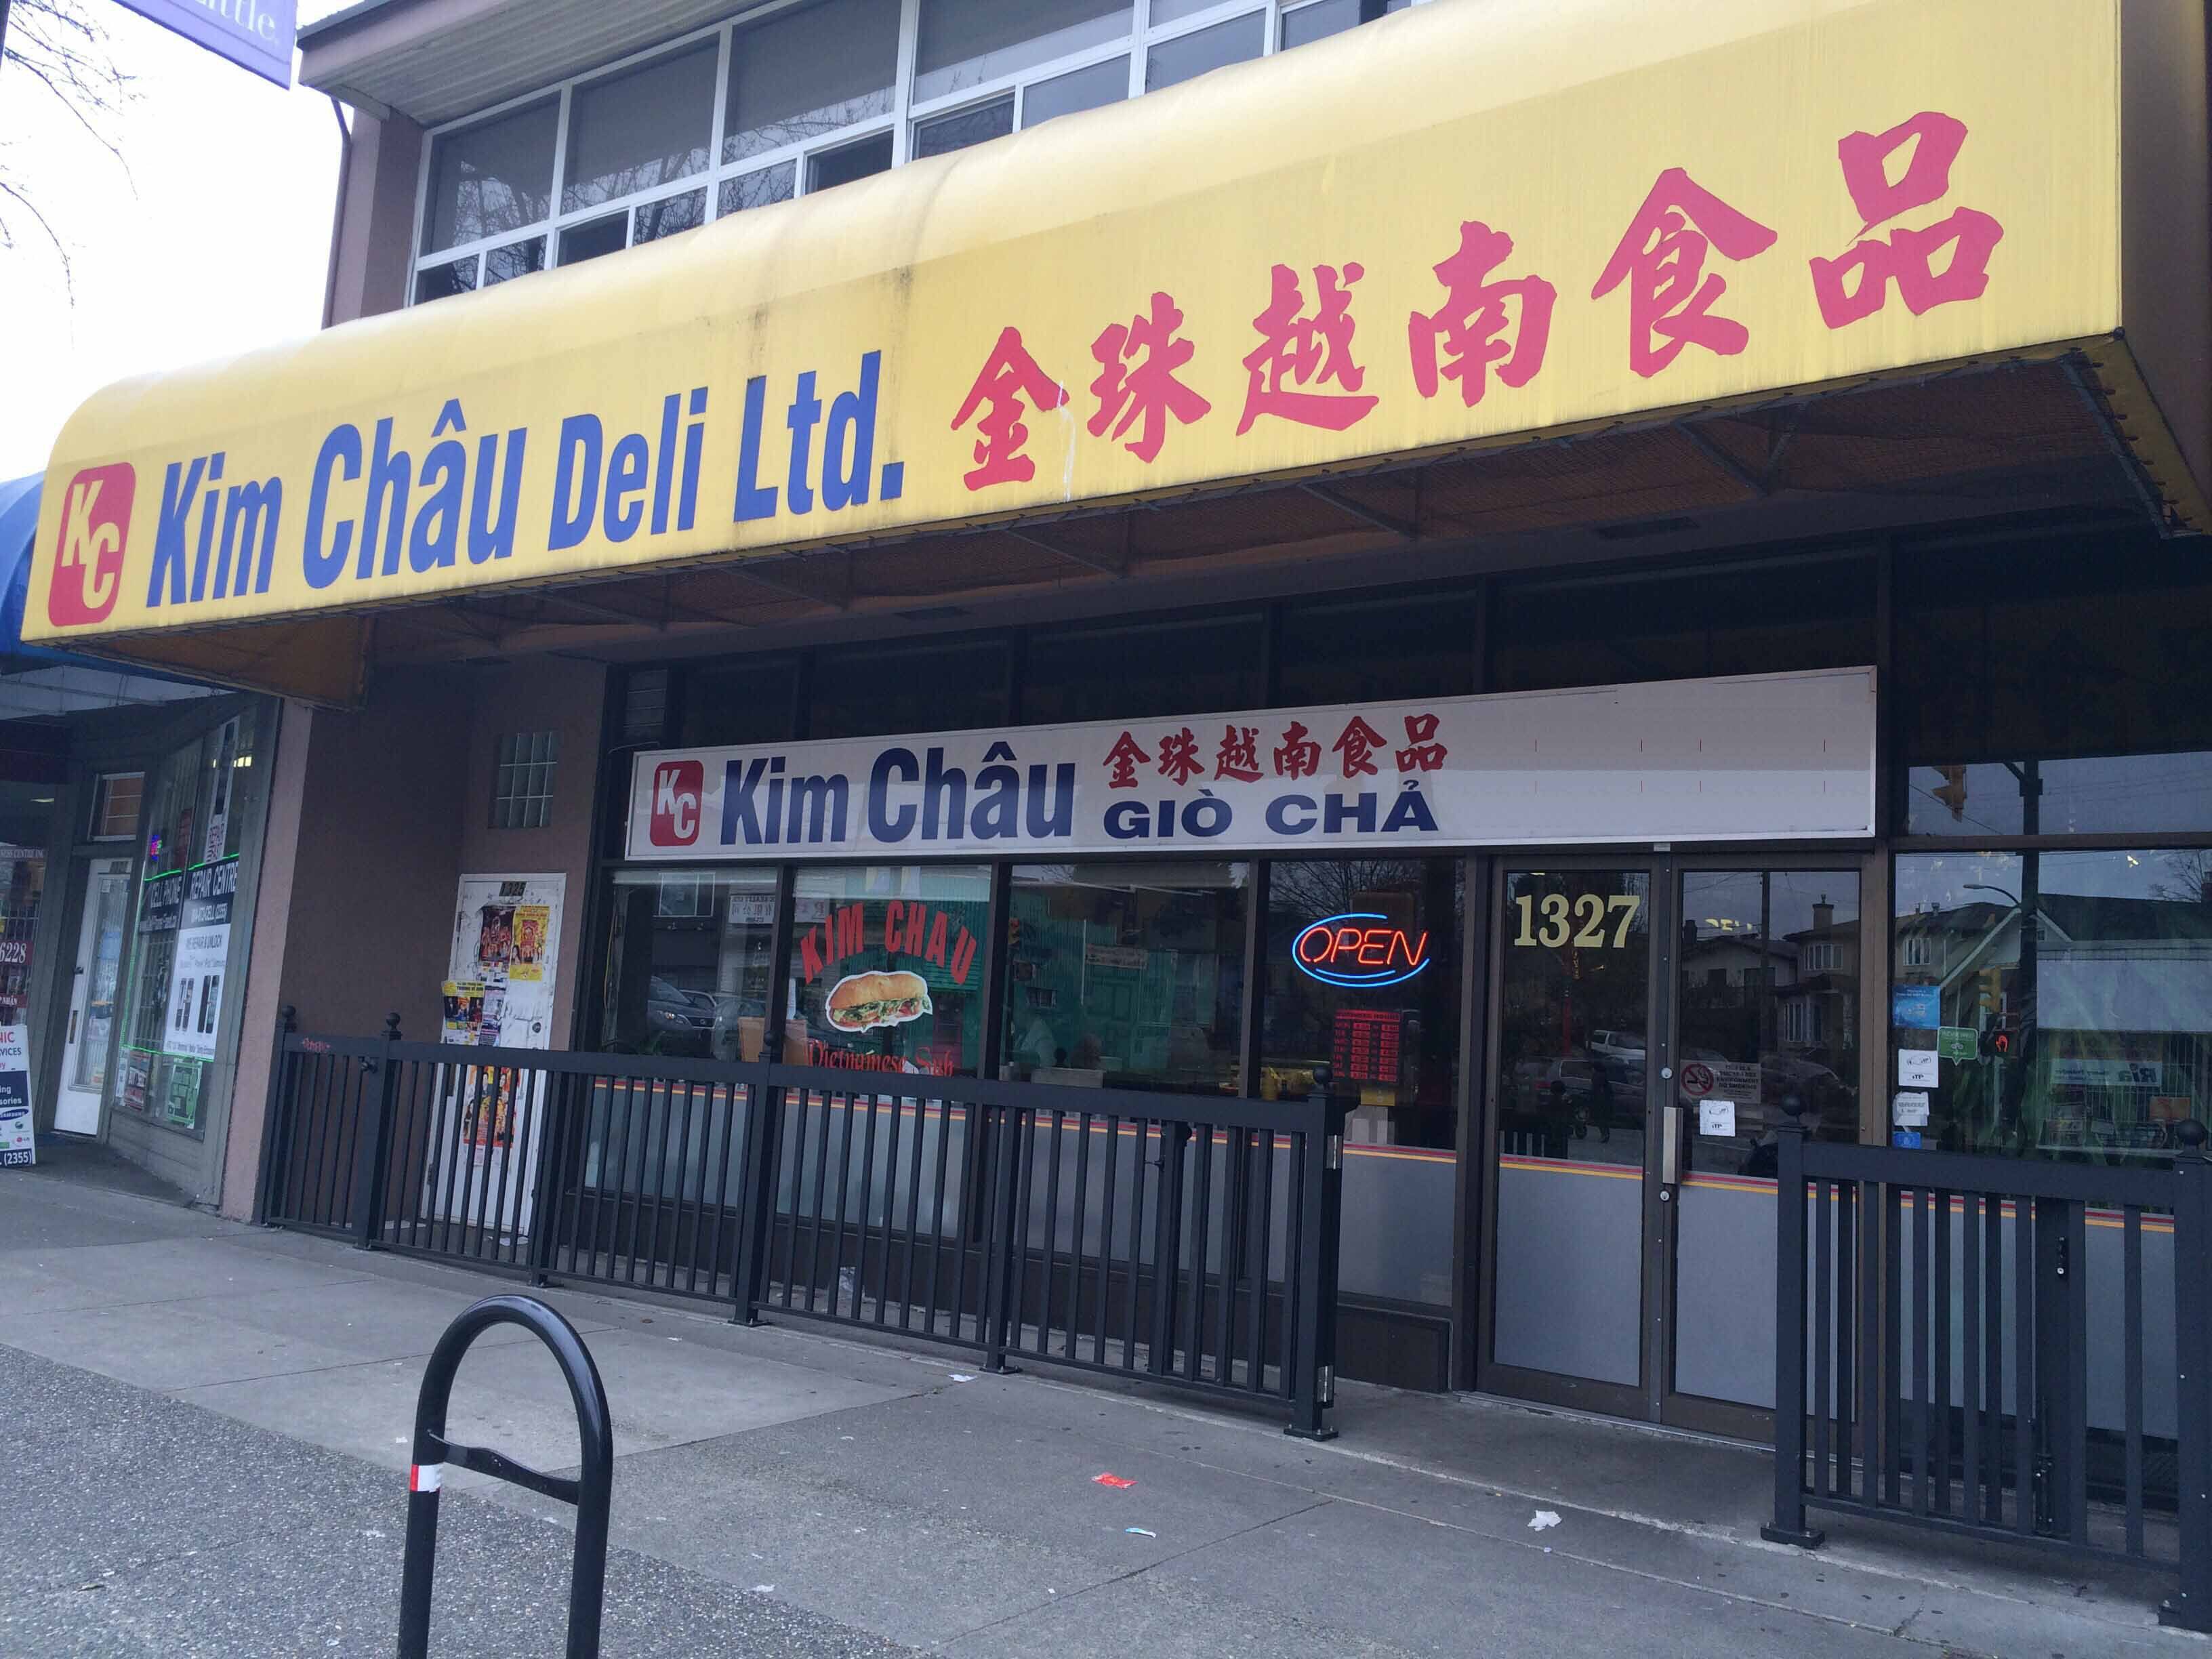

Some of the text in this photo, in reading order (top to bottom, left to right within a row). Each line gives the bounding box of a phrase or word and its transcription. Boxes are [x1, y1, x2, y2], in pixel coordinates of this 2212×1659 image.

[950, 111, 2004, 491] 金珠越南食品
[146, 350, 904, 609] Kim Châu Deli Ltd.
[61, 479, 121, 609] KC
[1103, 714, 1448, 789] 金珠越南食品
[657, 769, 697, 839] KC
[720, 741, 1076, 845] Kim Châu
[1103, 779, 1438, 839] GIÒ CHẢ
[190, 868, 212, 901] REPAIR
[213, 861, 239, 895] CENTRE
[800, 900, 976, 984] KIM CHAU
[1299, 926, 1429, 966] OPEN
[1514, 893, 1640, 948] 1327
[803, 1037, 907, 1073] Vietnamese
[4, 1151, 32, 1164] (2355)
